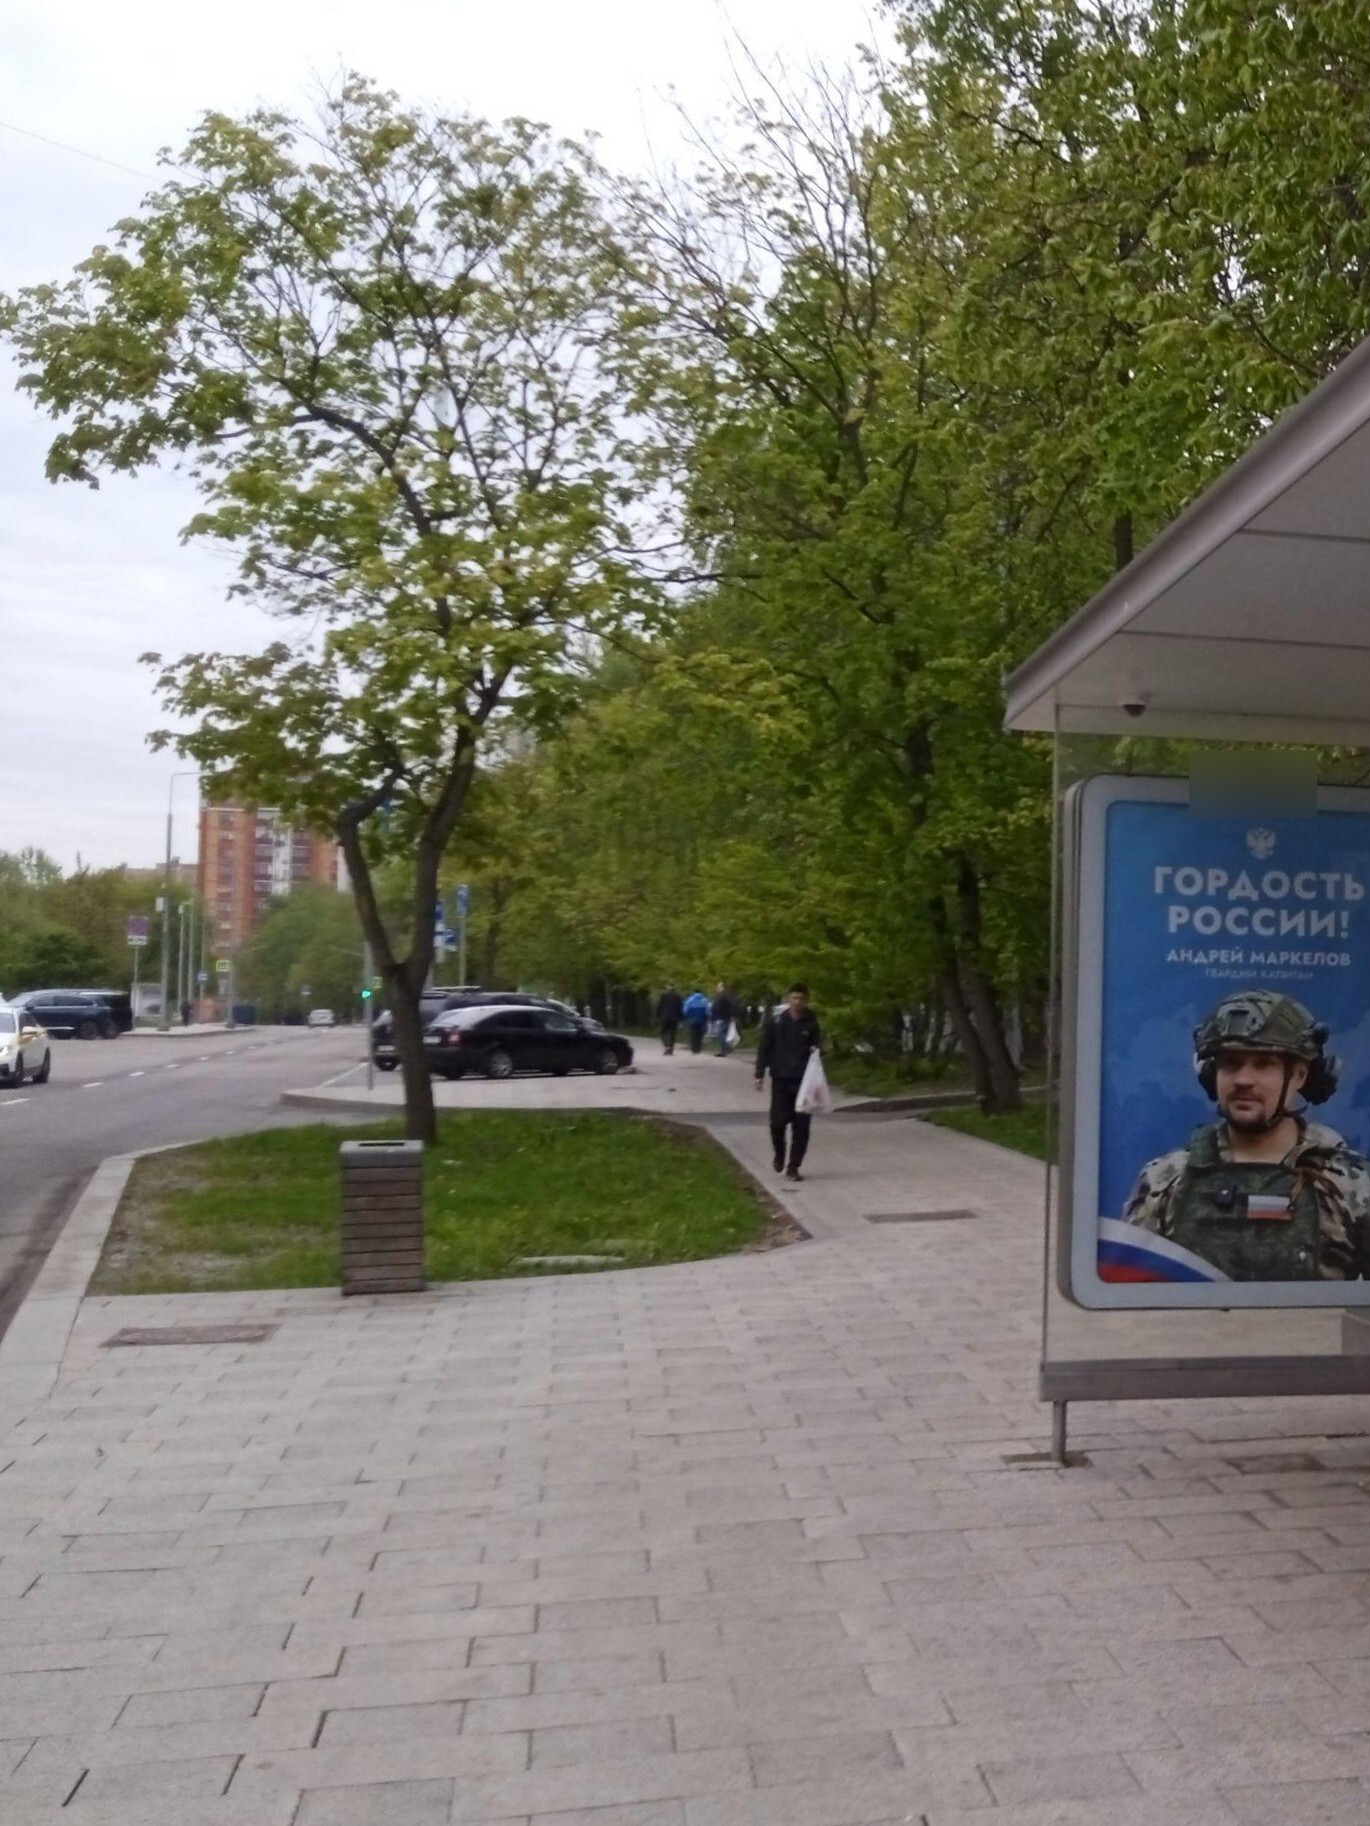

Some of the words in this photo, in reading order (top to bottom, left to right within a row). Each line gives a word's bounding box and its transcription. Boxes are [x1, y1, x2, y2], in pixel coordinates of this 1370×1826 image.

[1154, 866, 1366, 902] ГОРДОСТЬ
[1168, 905, 1351, 940] РОССИИ!
[1166, 946, 1244, 965] АНДРЕЙ
[1250, 951, 1352, 967] МАРКЕЛОВ
